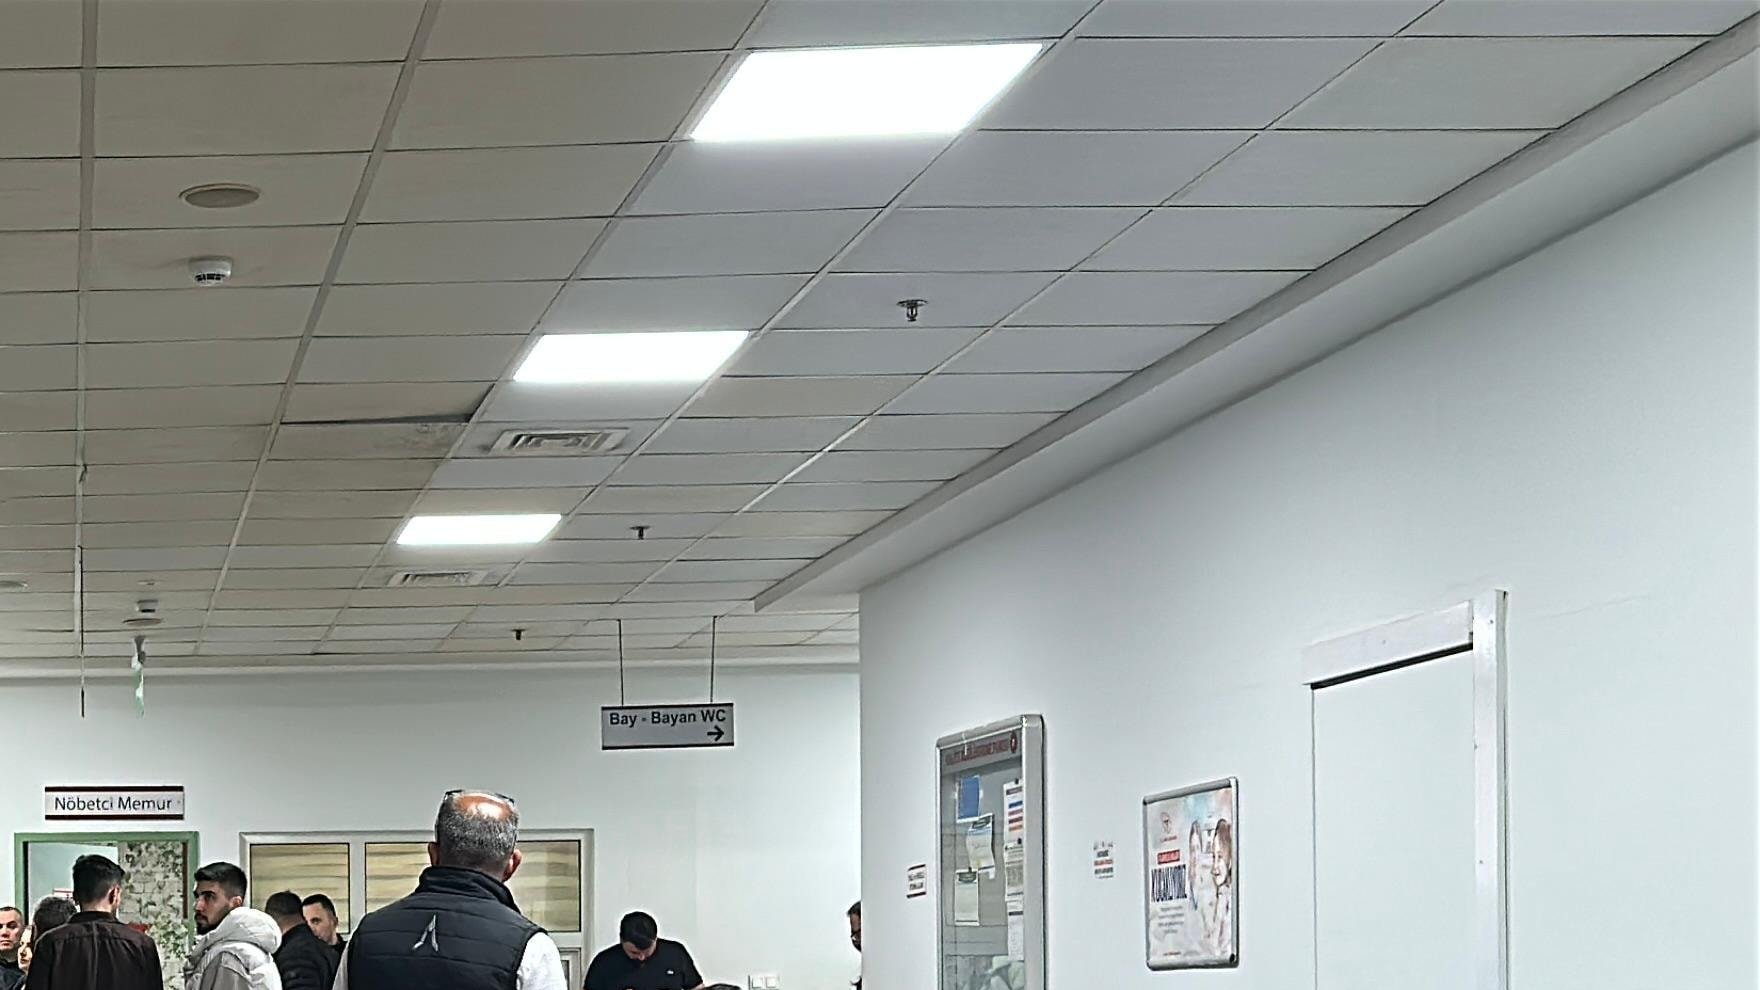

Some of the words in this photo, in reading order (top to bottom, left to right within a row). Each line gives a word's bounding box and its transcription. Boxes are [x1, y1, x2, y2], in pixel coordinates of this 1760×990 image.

[609, 711, 638, 728] Bay
[651, 710, 697, 727] Bayan
[700, 708, 727, 723] WC
[117, 796, 173, 811] Memur
